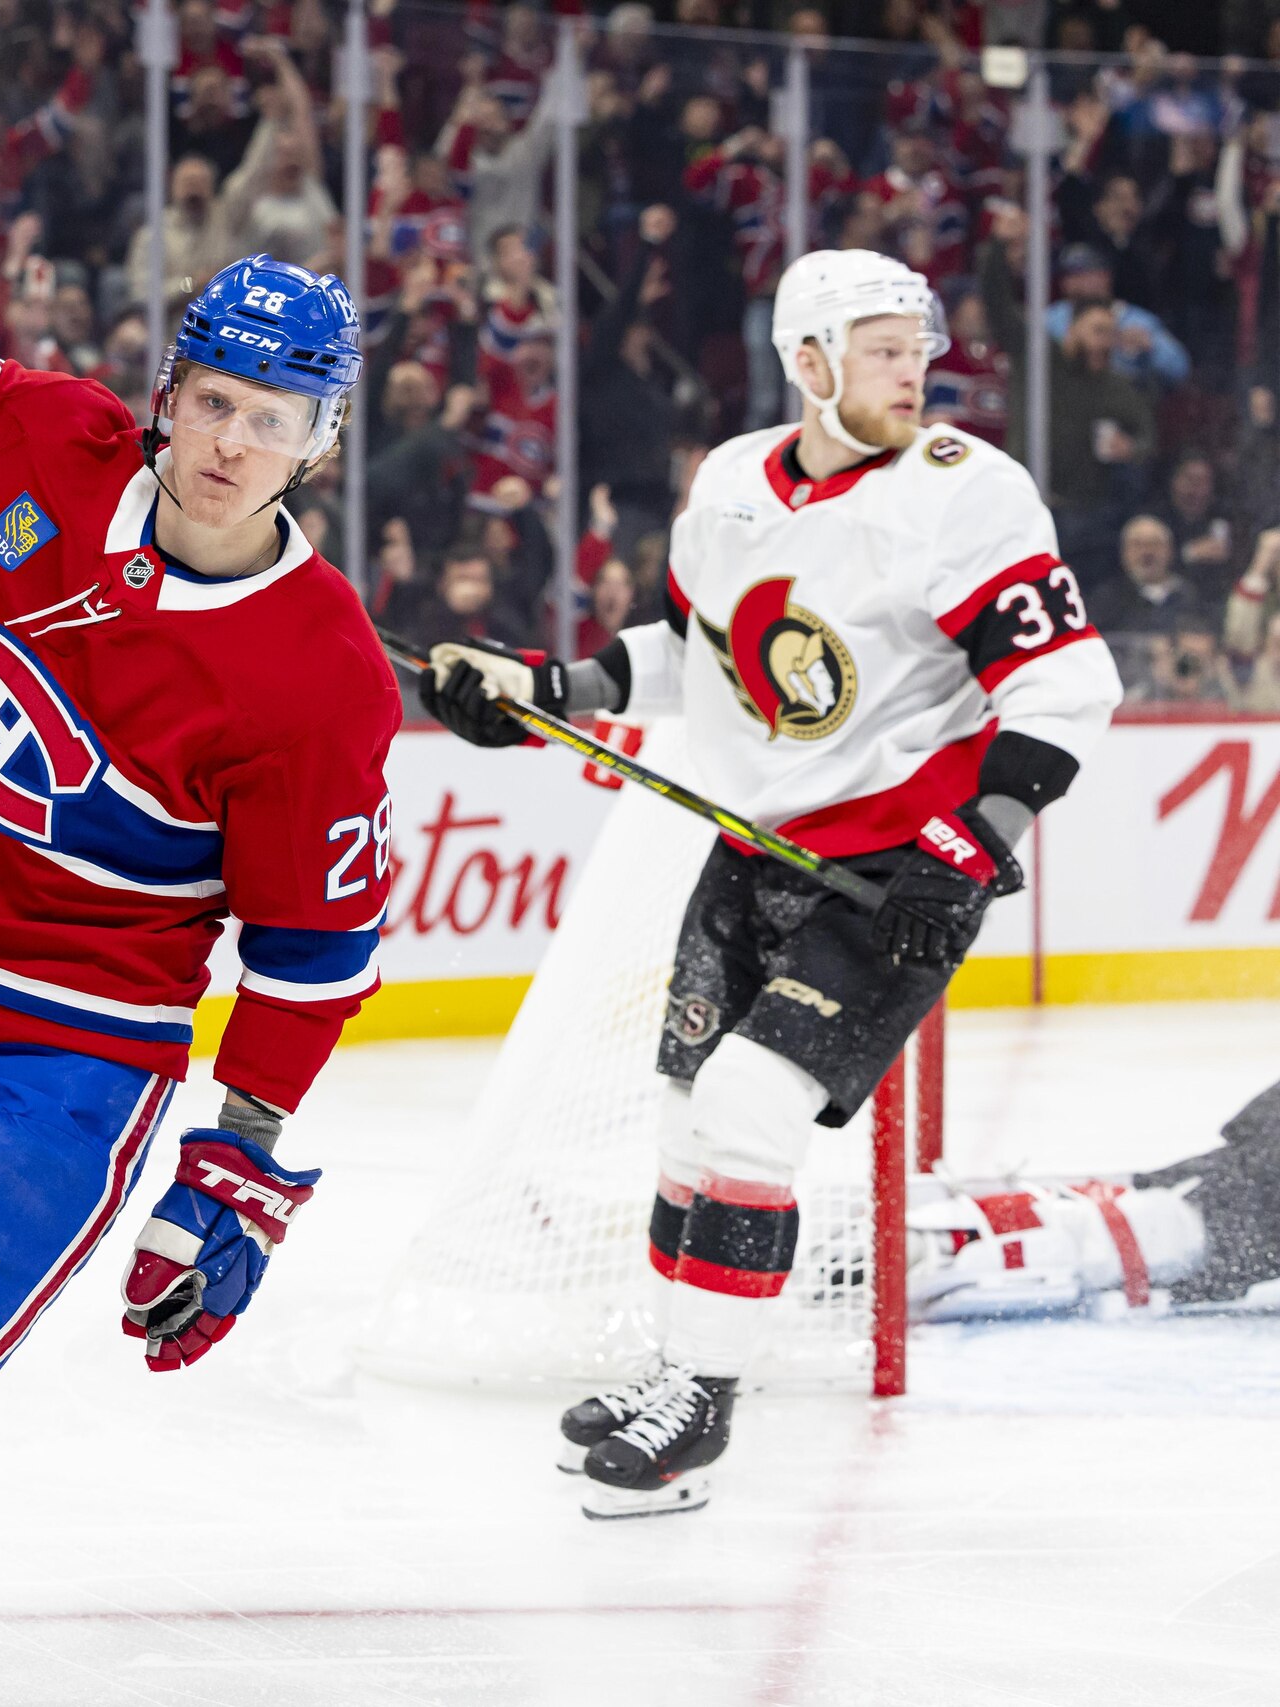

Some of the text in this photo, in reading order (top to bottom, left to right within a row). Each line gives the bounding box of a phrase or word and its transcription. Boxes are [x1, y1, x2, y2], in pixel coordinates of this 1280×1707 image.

[243, 286, 288, 314] 28
[219, 325, 283, 351] CCM
[127, 567, 151, 577] LNH
[996, 566, 1087, 649] 33
[325, 793, 390, 902] 28
